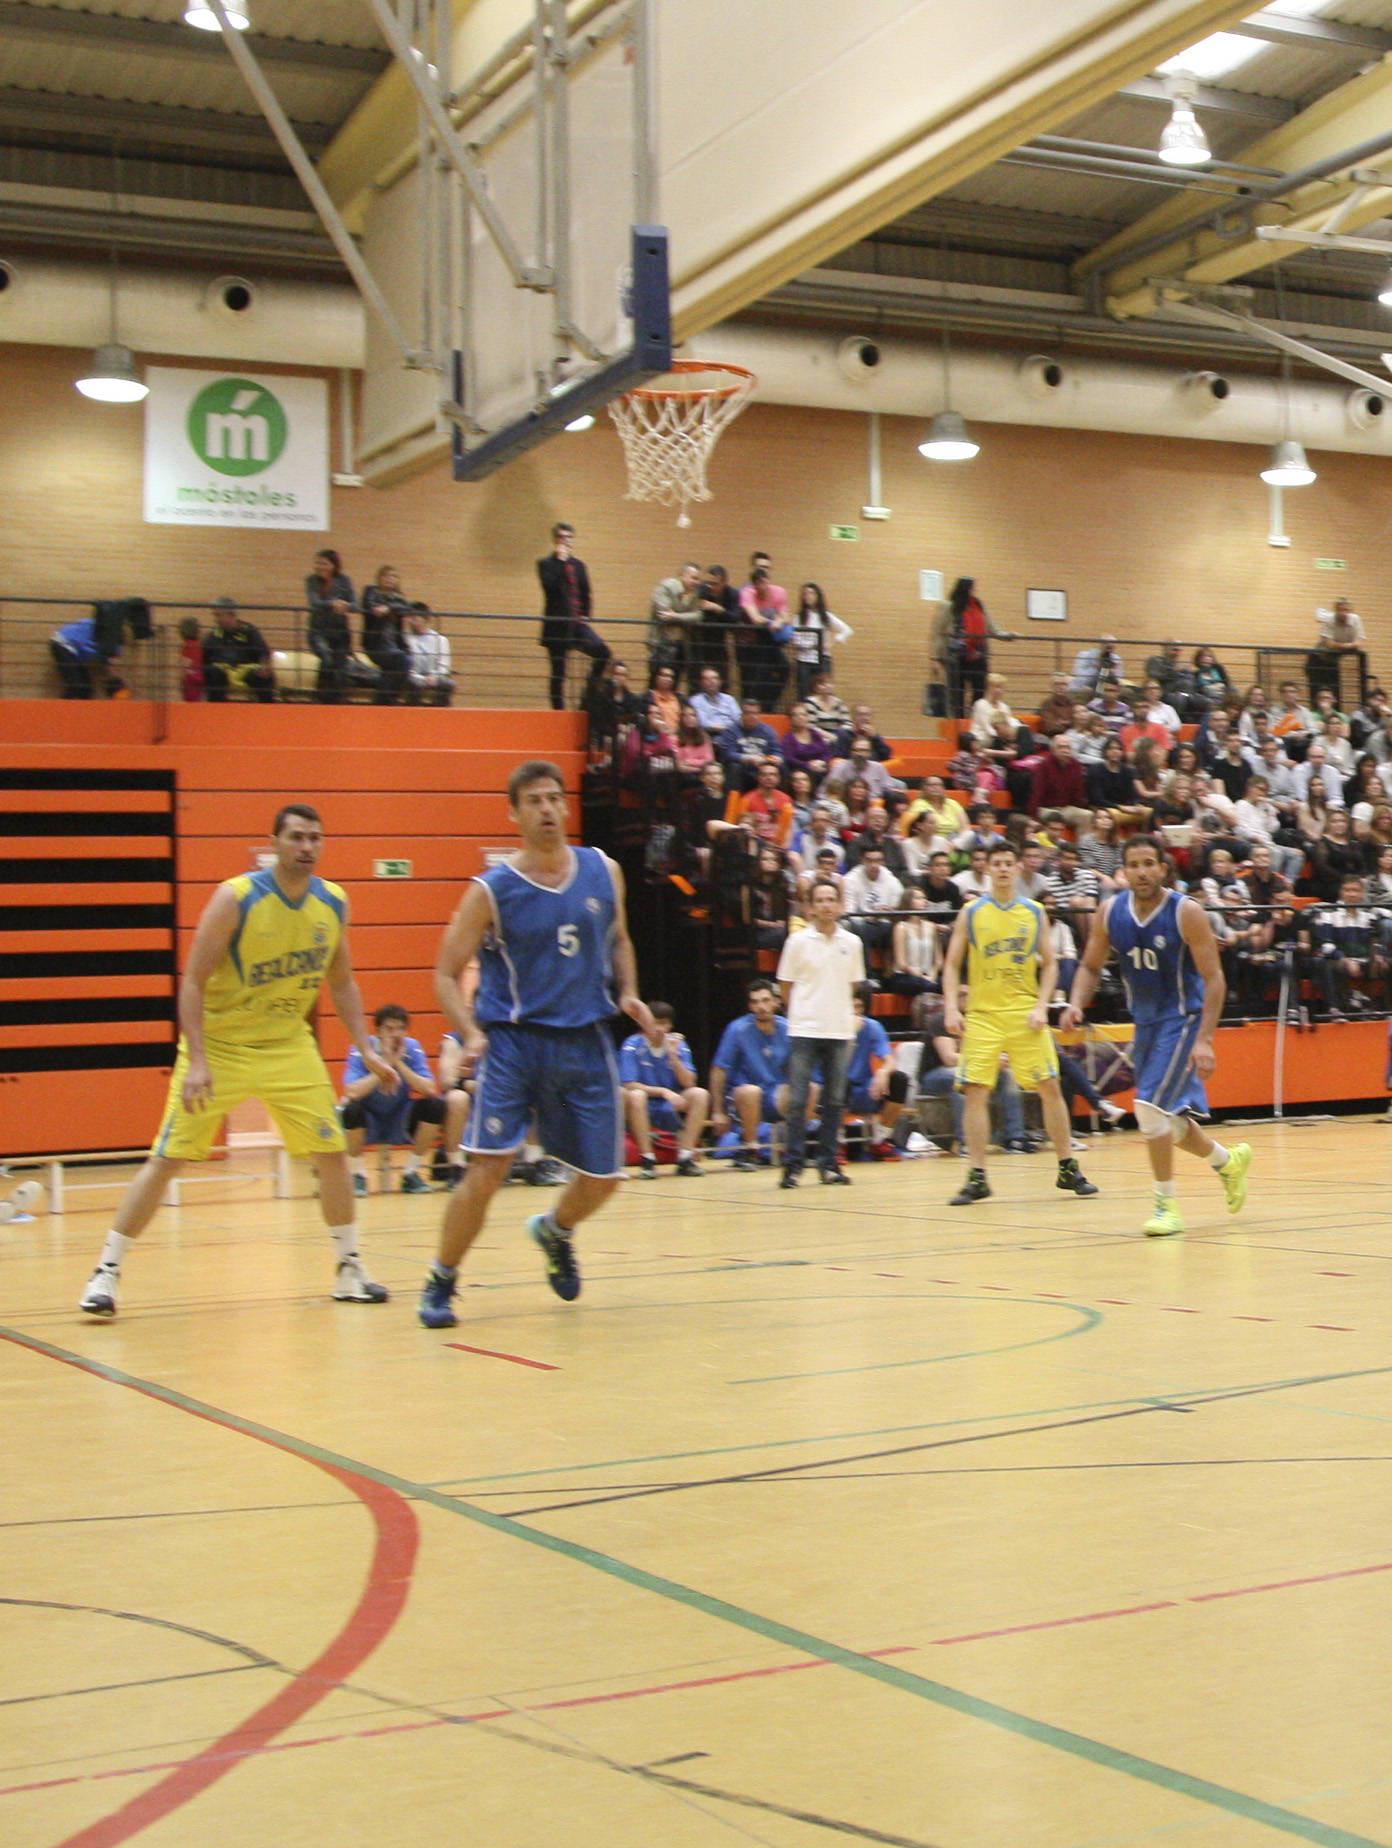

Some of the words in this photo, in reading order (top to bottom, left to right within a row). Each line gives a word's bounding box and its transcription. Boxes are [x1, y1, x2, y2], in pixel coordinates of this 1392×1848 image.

[177, 481, 296, 507] móstoles
[557, 923, 580, 957] 5
[1126, 946, 1159, 970] 10
